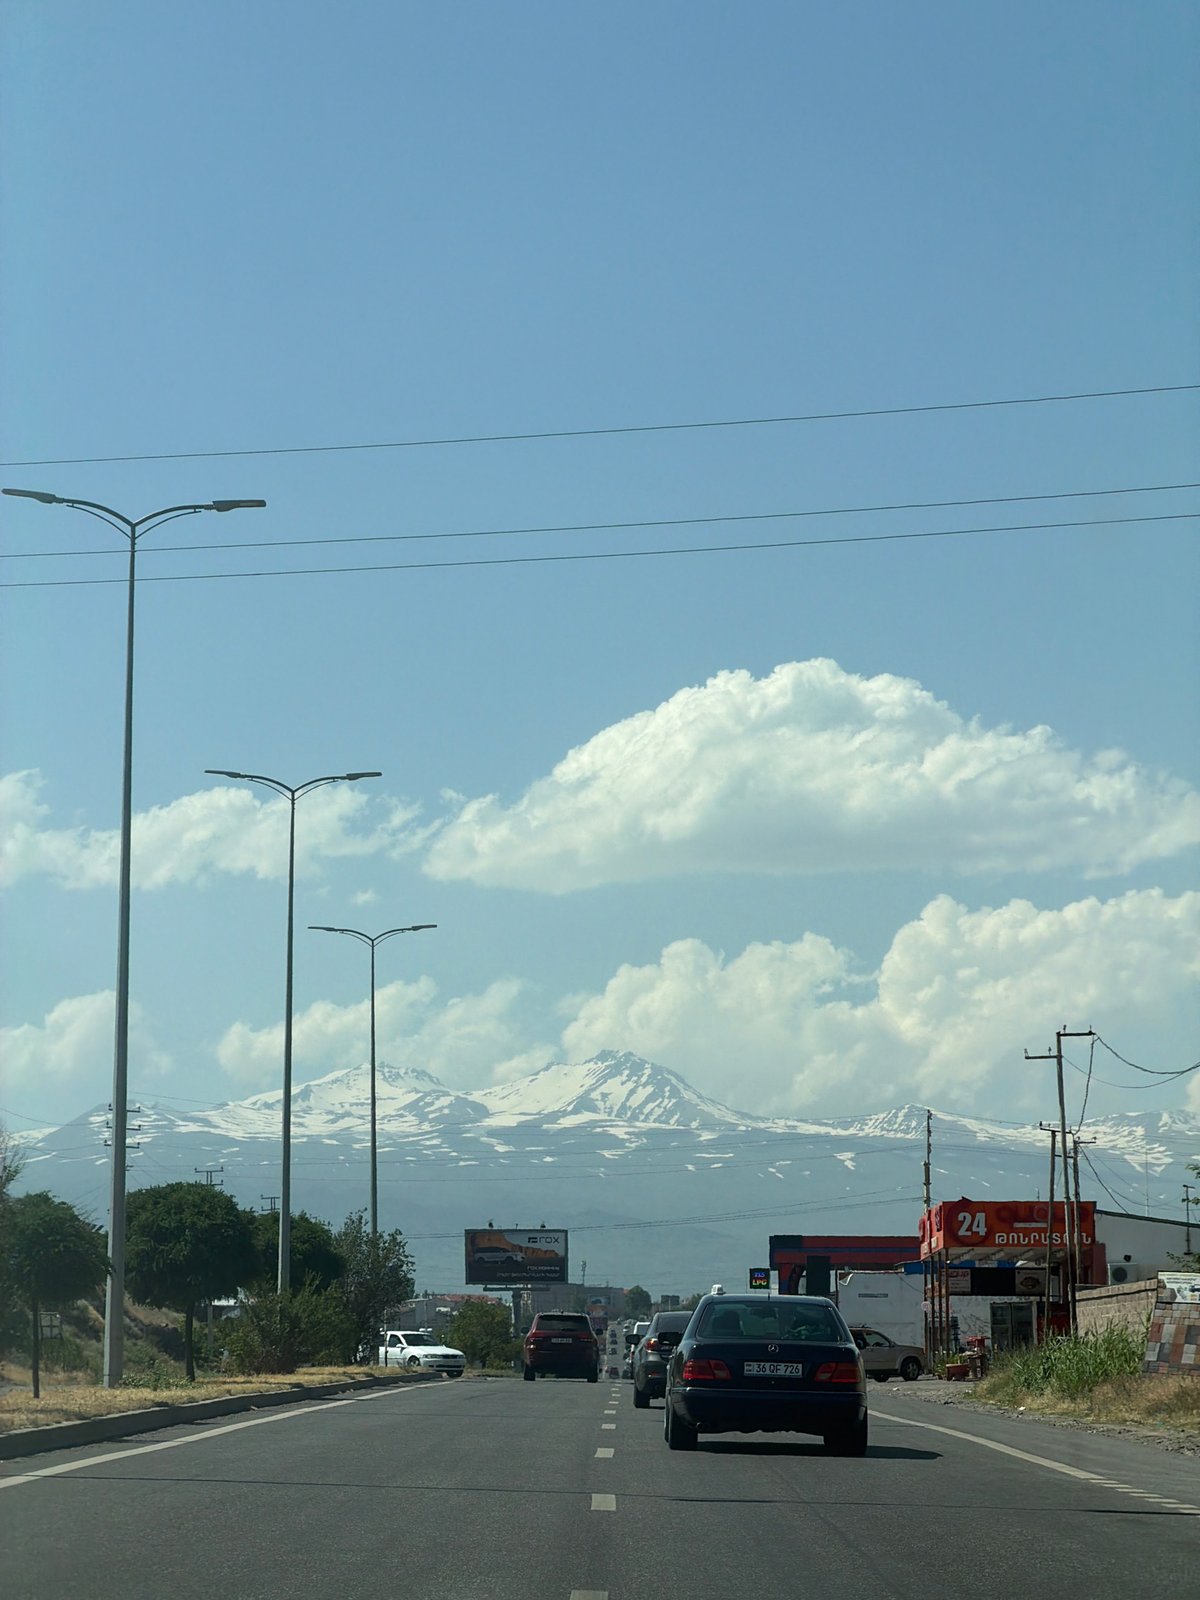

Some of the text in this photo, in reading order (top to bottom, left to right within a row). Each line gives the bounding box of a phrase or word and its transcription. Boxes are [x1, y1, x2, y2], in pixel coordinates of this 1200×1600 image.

[958, 1212, 987, 1237] 24
[756, 1363, 767, 1373] 36
[783, 1364, 800, 1374] 726
